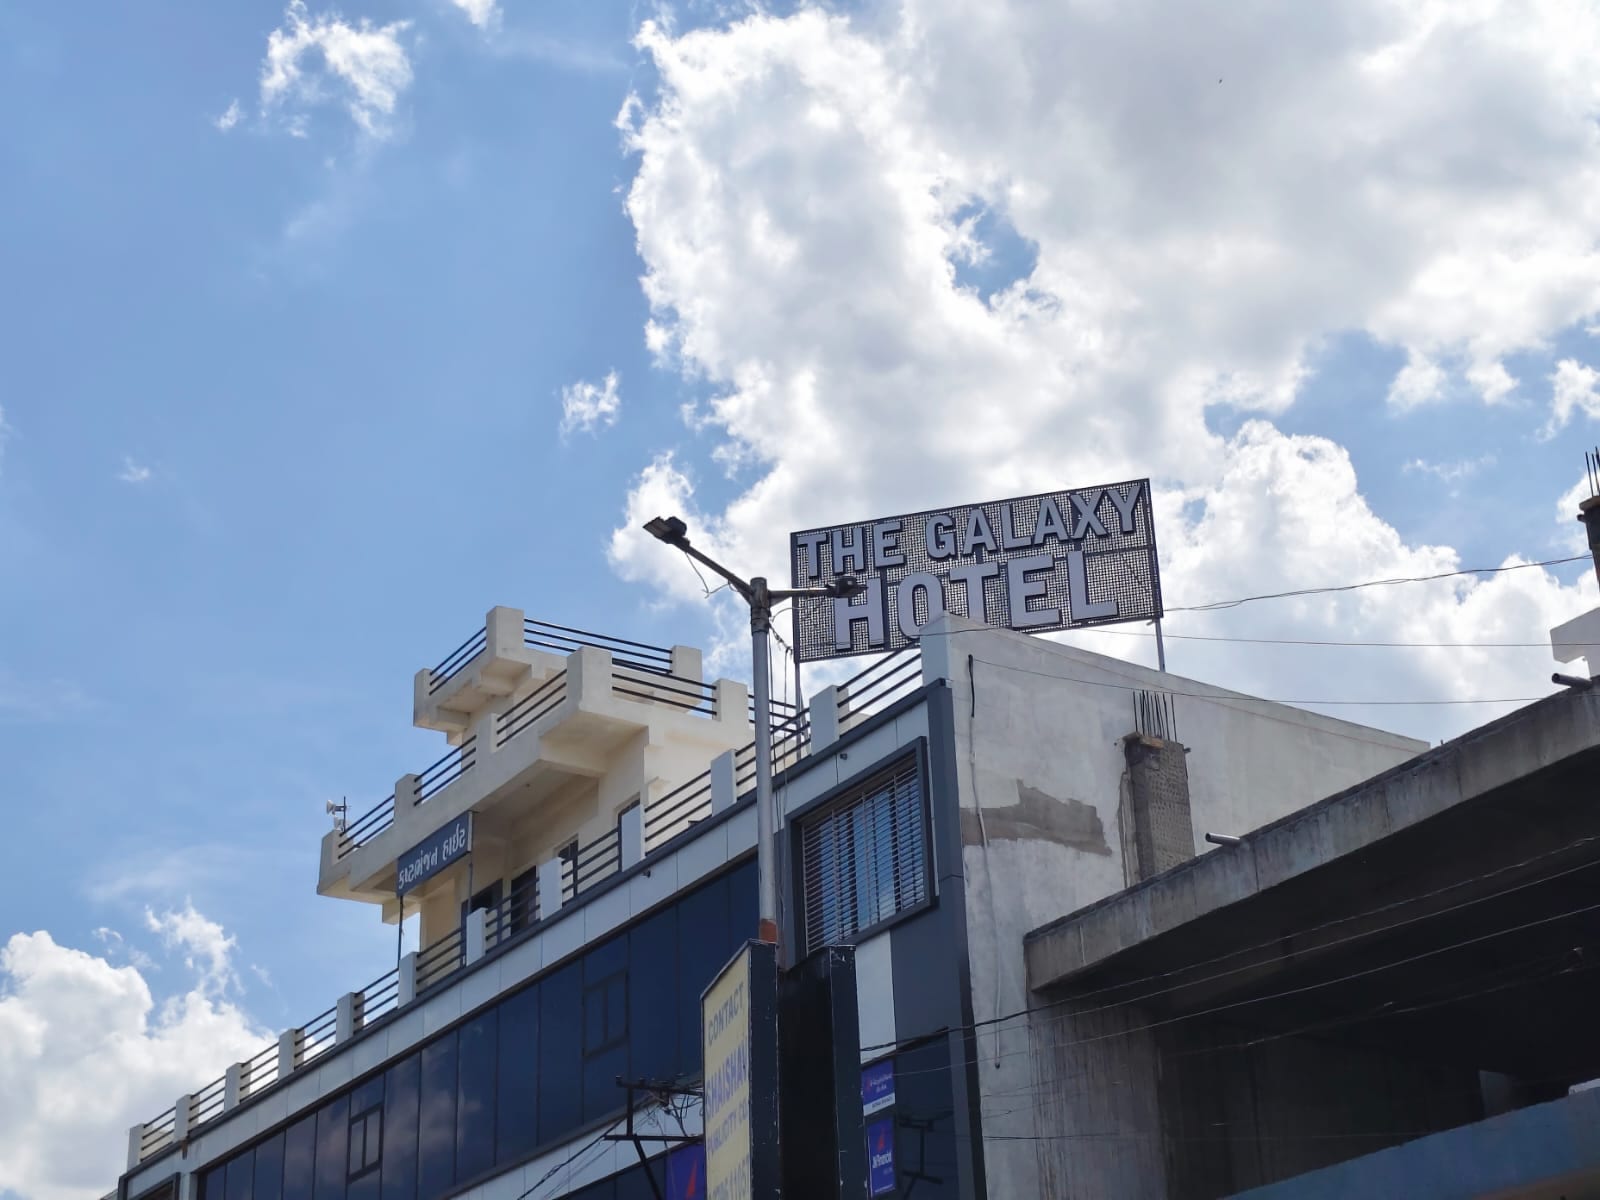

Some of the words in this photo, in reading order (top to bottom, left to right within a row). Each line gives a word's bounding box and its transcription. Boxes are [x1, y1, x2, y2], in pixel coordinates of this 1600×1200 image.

[797, 520, 905, 578] THE
[925, 485, 1142, 559] GALAXY
[834, 550, 1118, 650] HOTEL
[708, 981, 744, 1047] CONTACT
